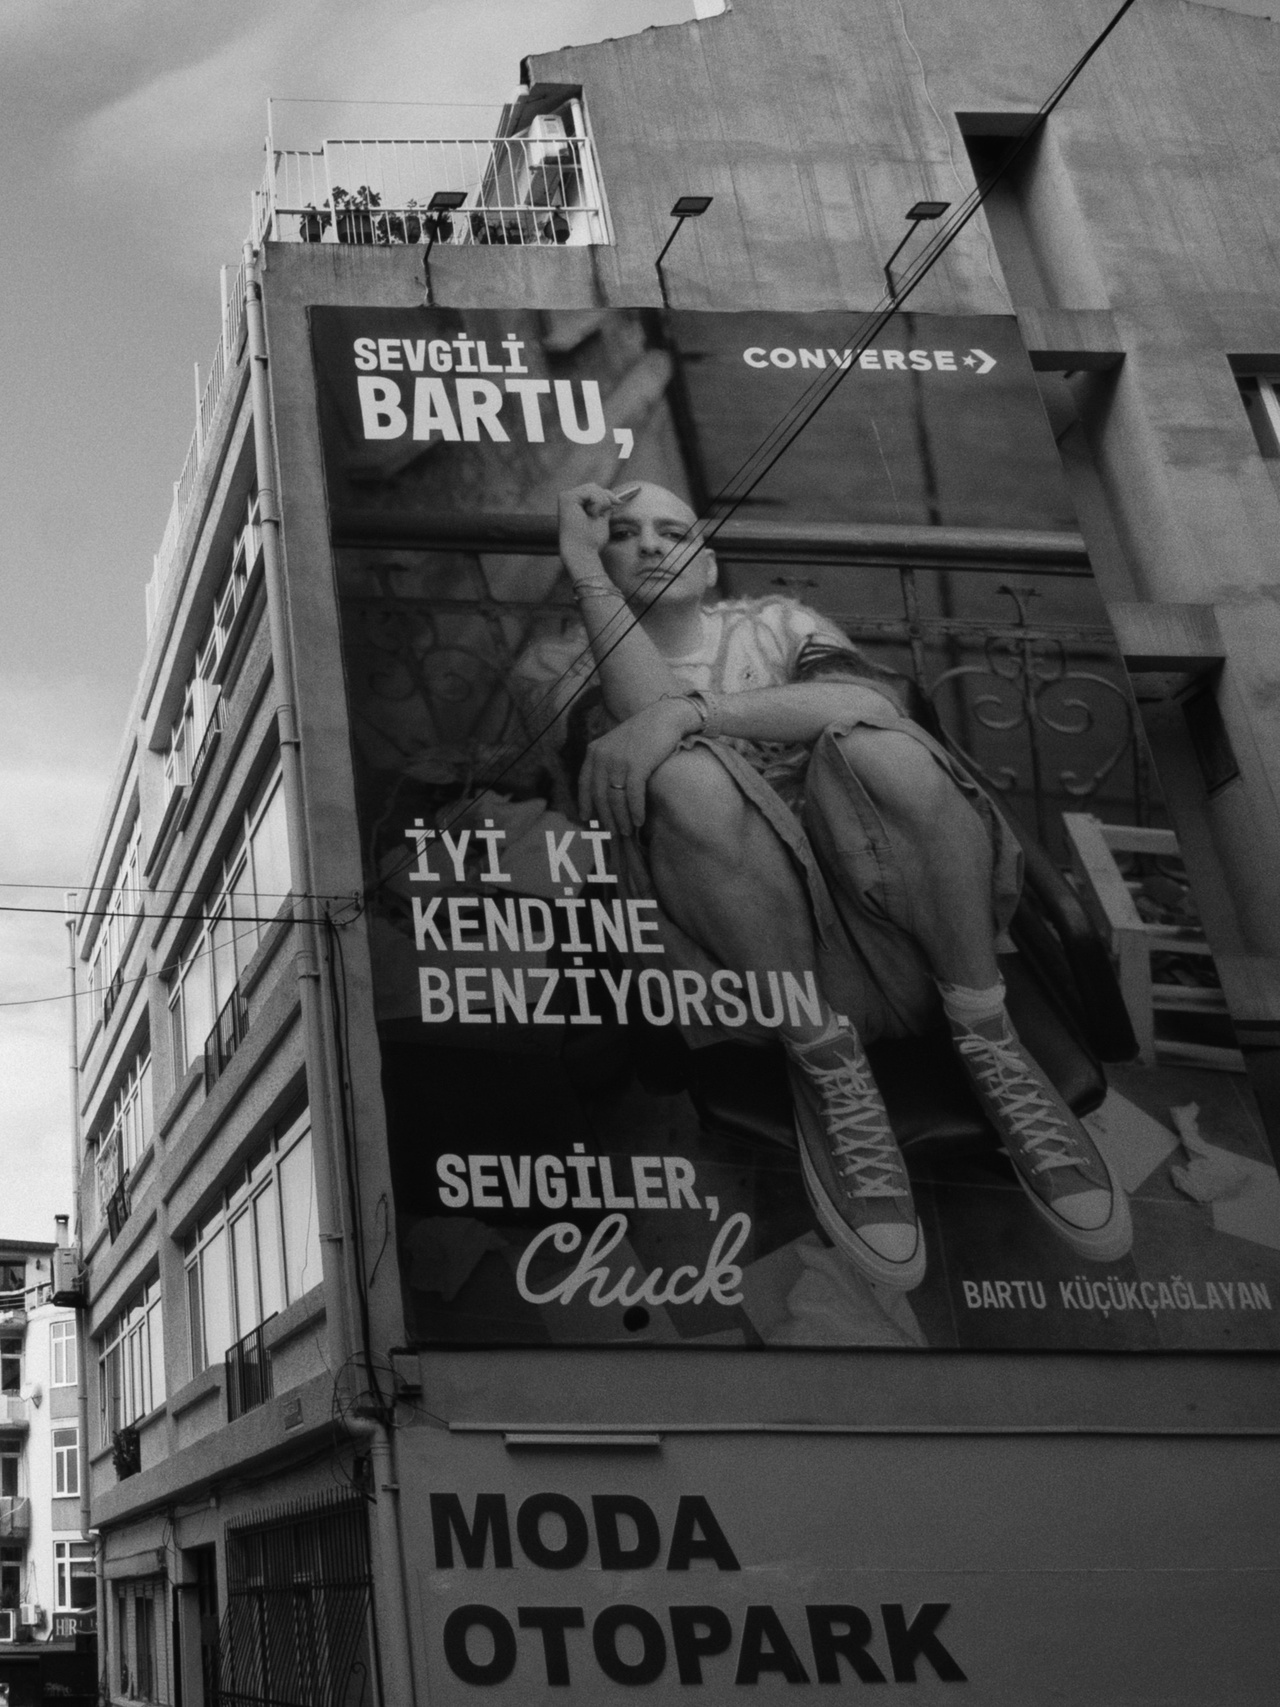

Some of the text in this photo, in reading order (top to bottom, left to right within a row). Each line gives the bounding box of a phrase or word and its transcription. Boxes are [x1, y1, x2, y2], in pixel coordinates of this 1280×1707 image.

[353, 332, 529, 374] SEVGİLİ
[743, 346, 959, 372] CONVERSE
[356, 376, 635, 459] BARTU,
[405, 818, 618, 883] İYİ Kİ
[411, 887, 665, 954] KENDİNE
[419, 957, 850, 1028] BENZİYORSUN.
[436, 1143, 720, 1221] SEVGİLER,
[516, 1213, 751, 1308] Chuck
[962, 1274, 1273, 1319] BARTU KÜÇÜKÇAĞLAYAN
[429, 1492, 742, 1572] MODA
[443, 1603, 969, 1687] OTOPARK
